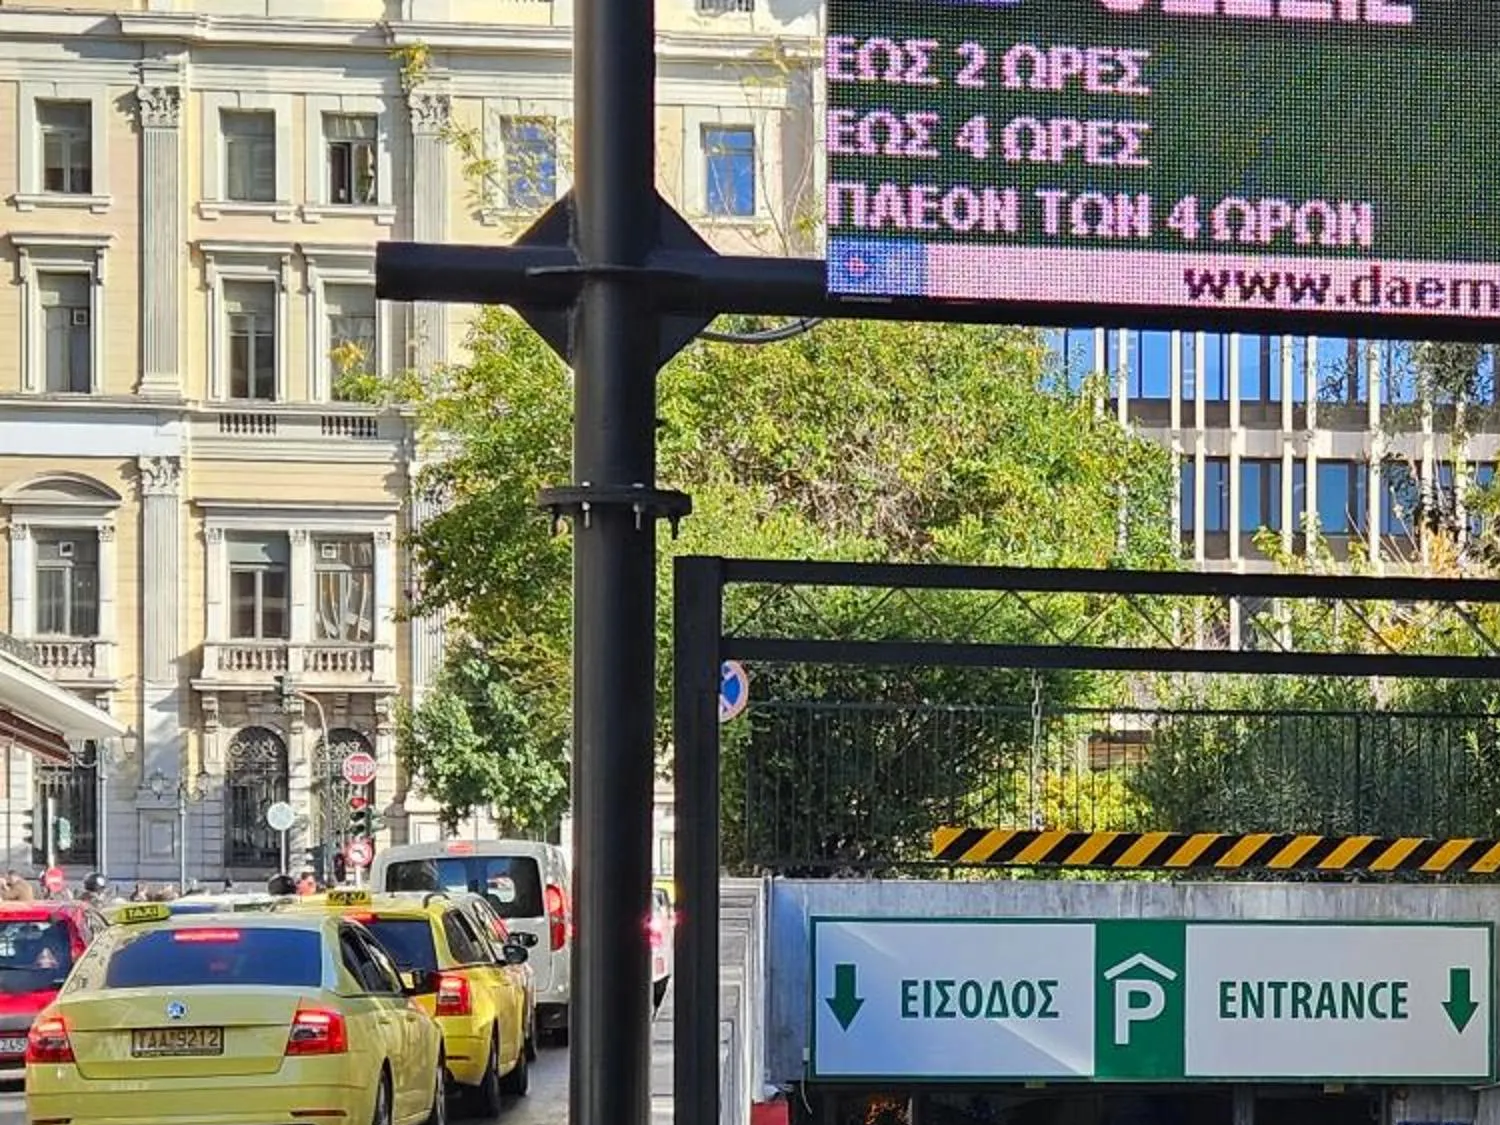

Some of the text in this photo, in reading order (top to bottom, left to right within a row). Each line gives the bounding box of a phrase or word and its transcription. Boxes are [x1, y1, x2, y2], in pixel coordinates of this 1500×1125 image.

[827, 35, 1152, 96] ΕΩΣ 2 ΩΡΕΣ
[827, 109, 1152, 168] ΕΩΣ 4 ΩΡΕΣ
[1035, 189, 1150, 239] ΤΩΝ
[1164, 195, 1198, 241] 4
[1212, 197, 1375, 247] ΩΡΩΝ
[900, 979, 1060, 1021] ΕΙΣΟΔΟΣ
[1113, 980, 1167, 1046] P
[1218, 980, 1410, 1021] ENTRANCE
